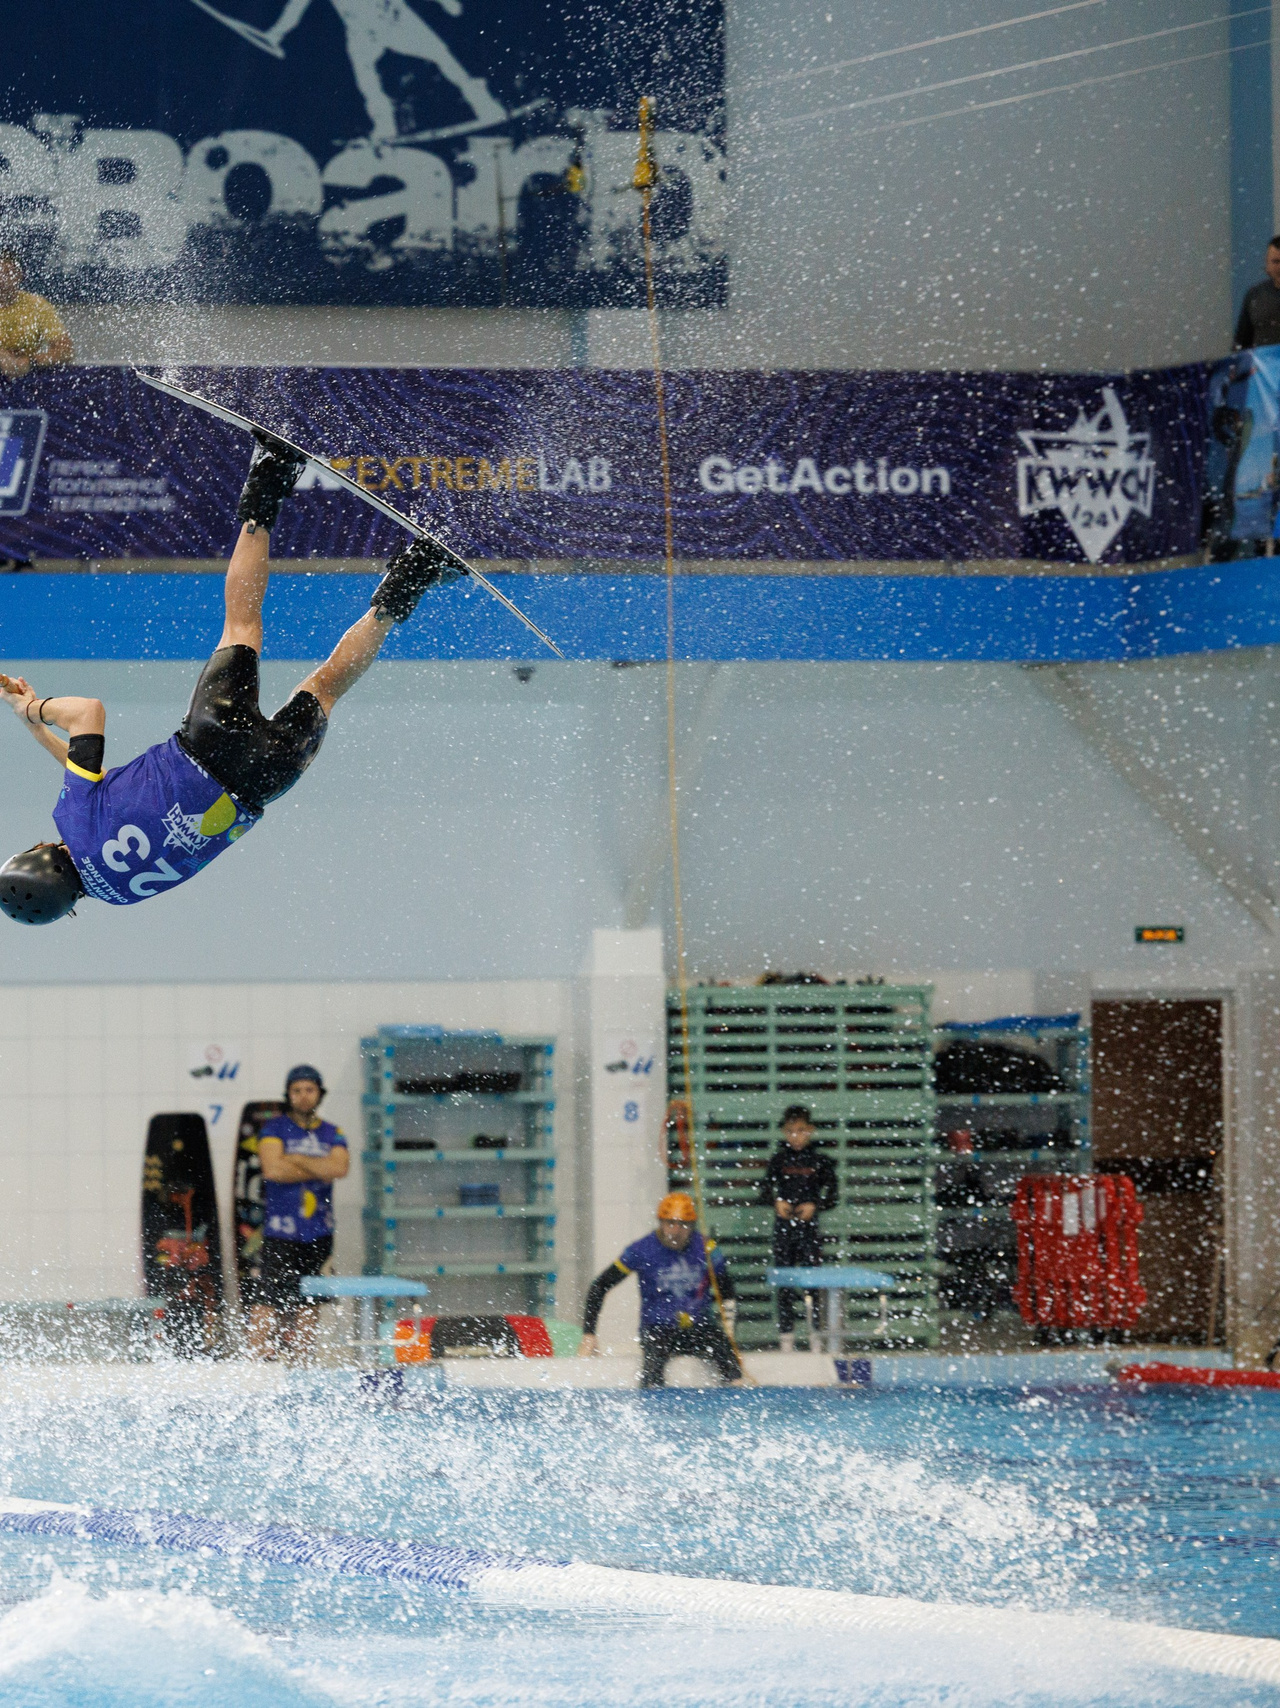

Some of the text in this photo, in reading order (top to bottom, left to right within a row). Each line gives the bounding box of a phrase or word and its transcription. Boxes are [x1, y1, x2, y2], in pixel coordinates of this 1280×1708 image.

[699, 456, 951, 495] GetAction
[169, 807, 207, 848] KWWCH
[102, 824, 183, 896] 23
[81, 857, 128, 903] CHALLENGE
[81, 869, 112, 901] WINTER
[209, 1104, 222, 1124] 7
[624, 1101, 639, 1122] 8
